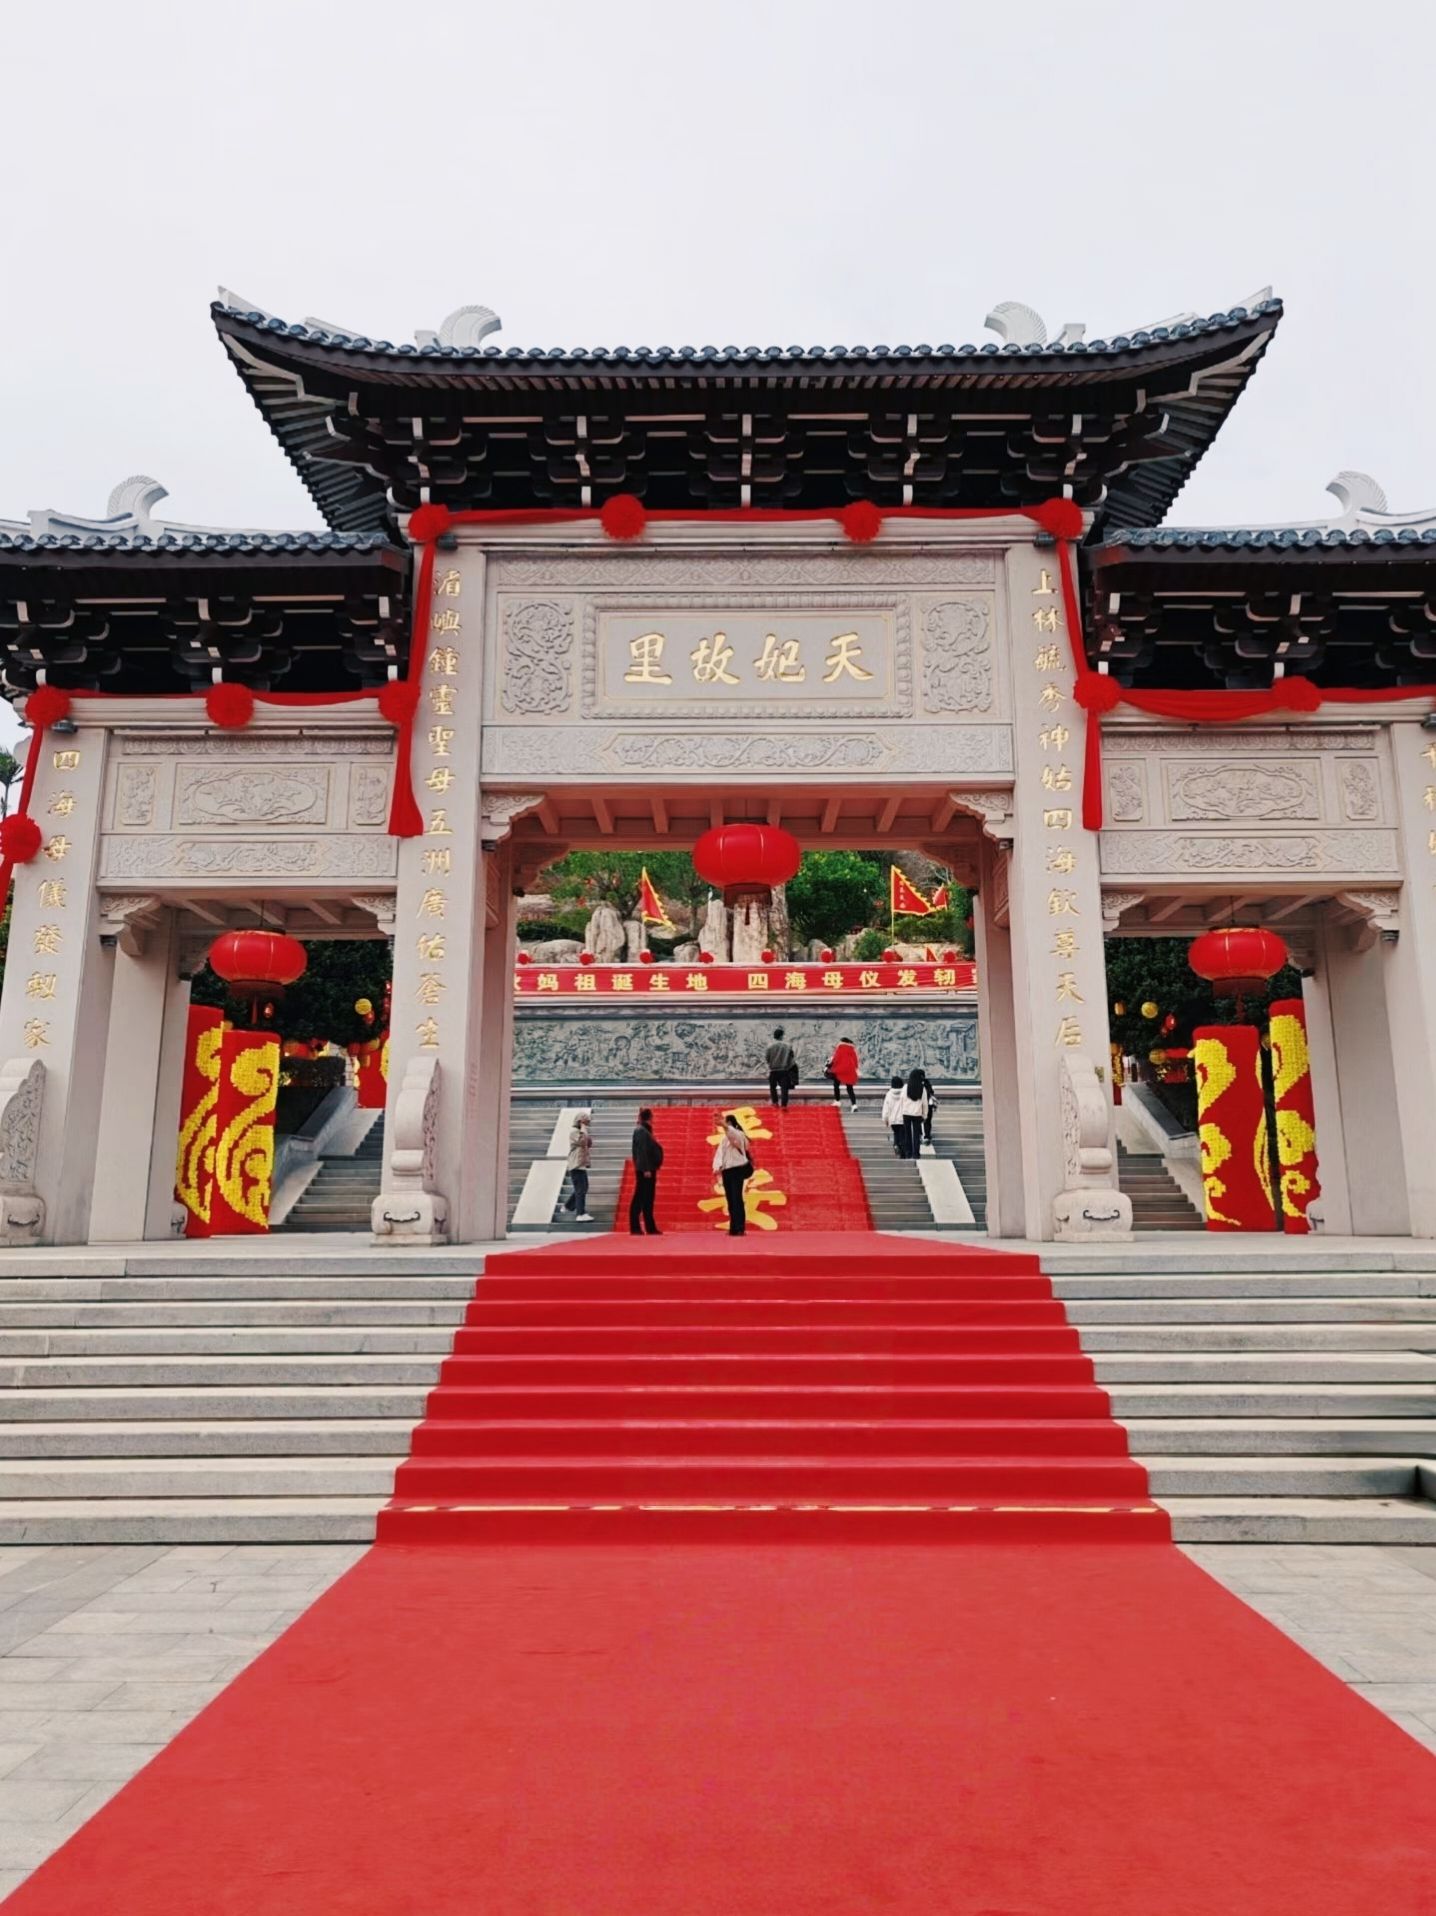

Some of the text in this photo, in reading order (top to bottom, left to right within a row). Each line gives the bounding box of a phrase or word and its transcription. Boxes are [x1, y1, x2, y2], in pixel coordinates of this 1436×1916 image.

[747, 968, 977, 990] 四海母仪发轫
